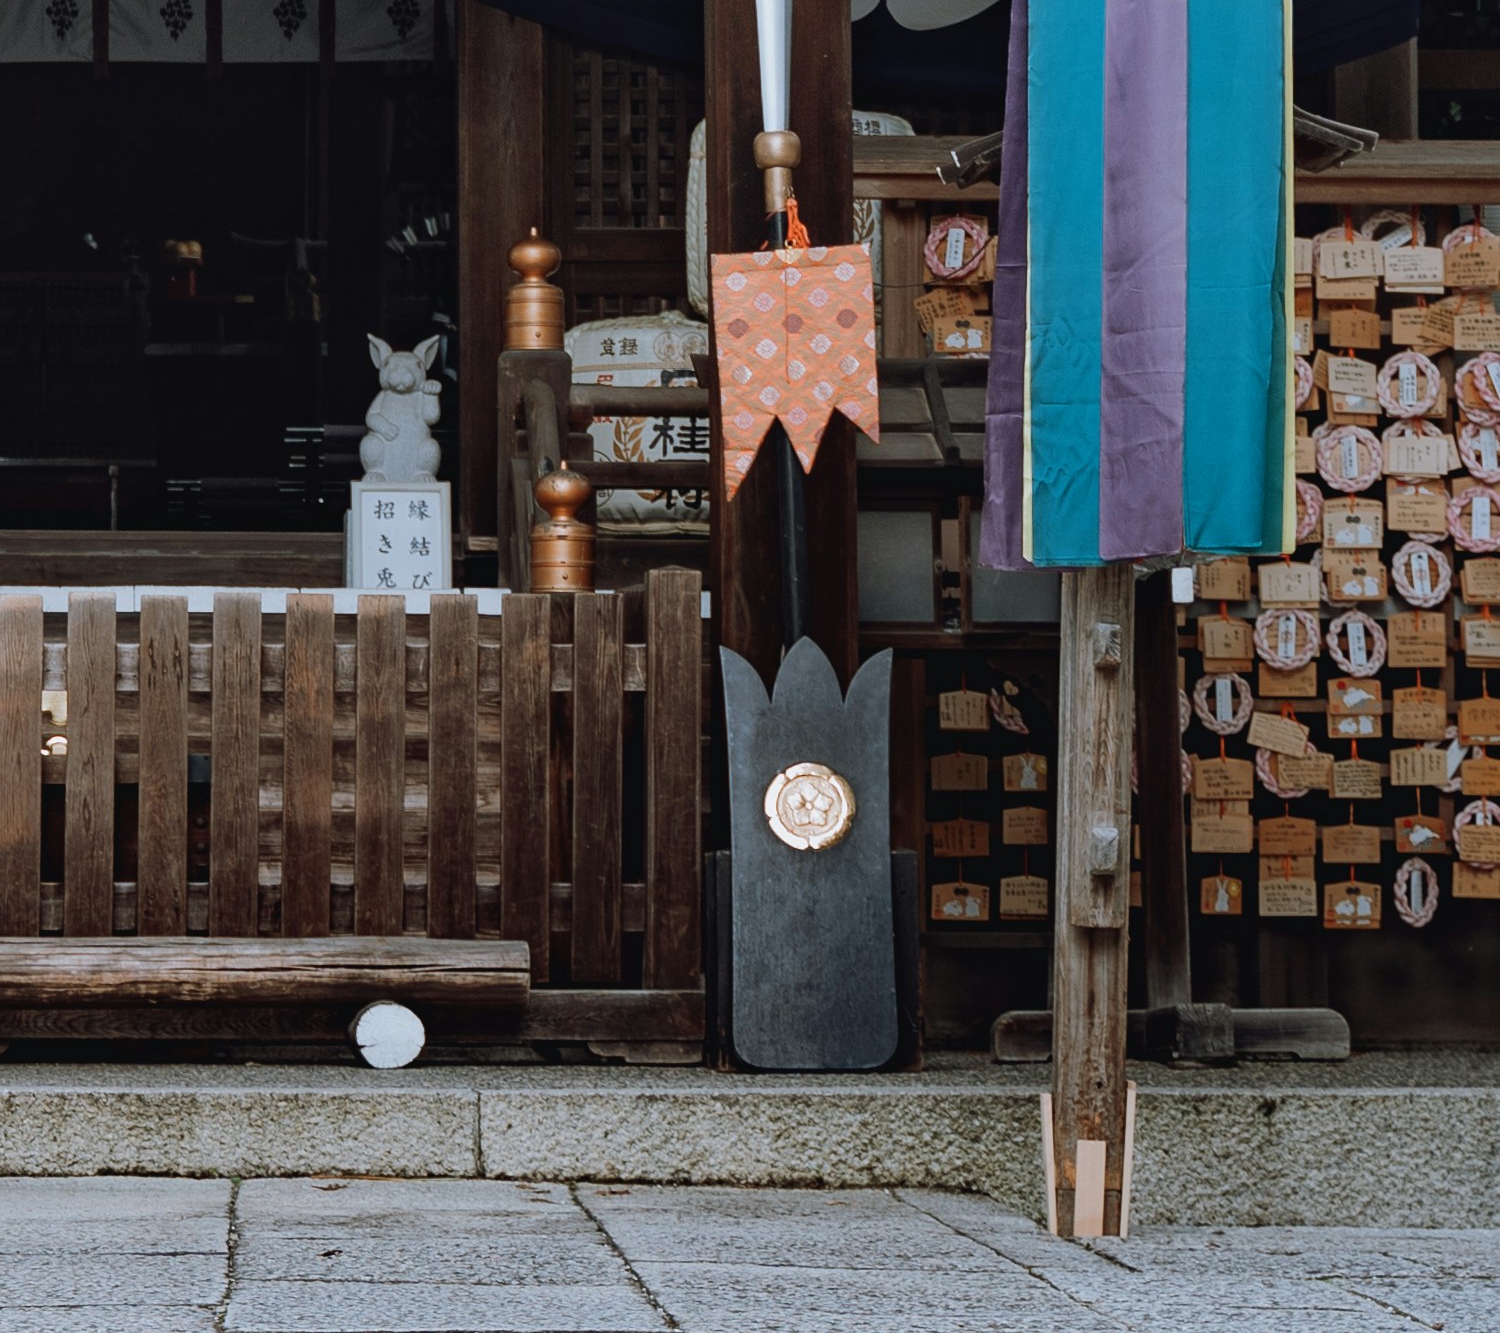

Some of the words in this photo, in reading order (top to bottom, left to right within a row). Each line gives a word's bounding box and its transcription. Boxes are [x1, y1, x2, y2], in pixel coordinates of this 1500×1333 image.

[374, 500, 397, 589] 招き兎
[408, 500, 433, 589] 縁結び
